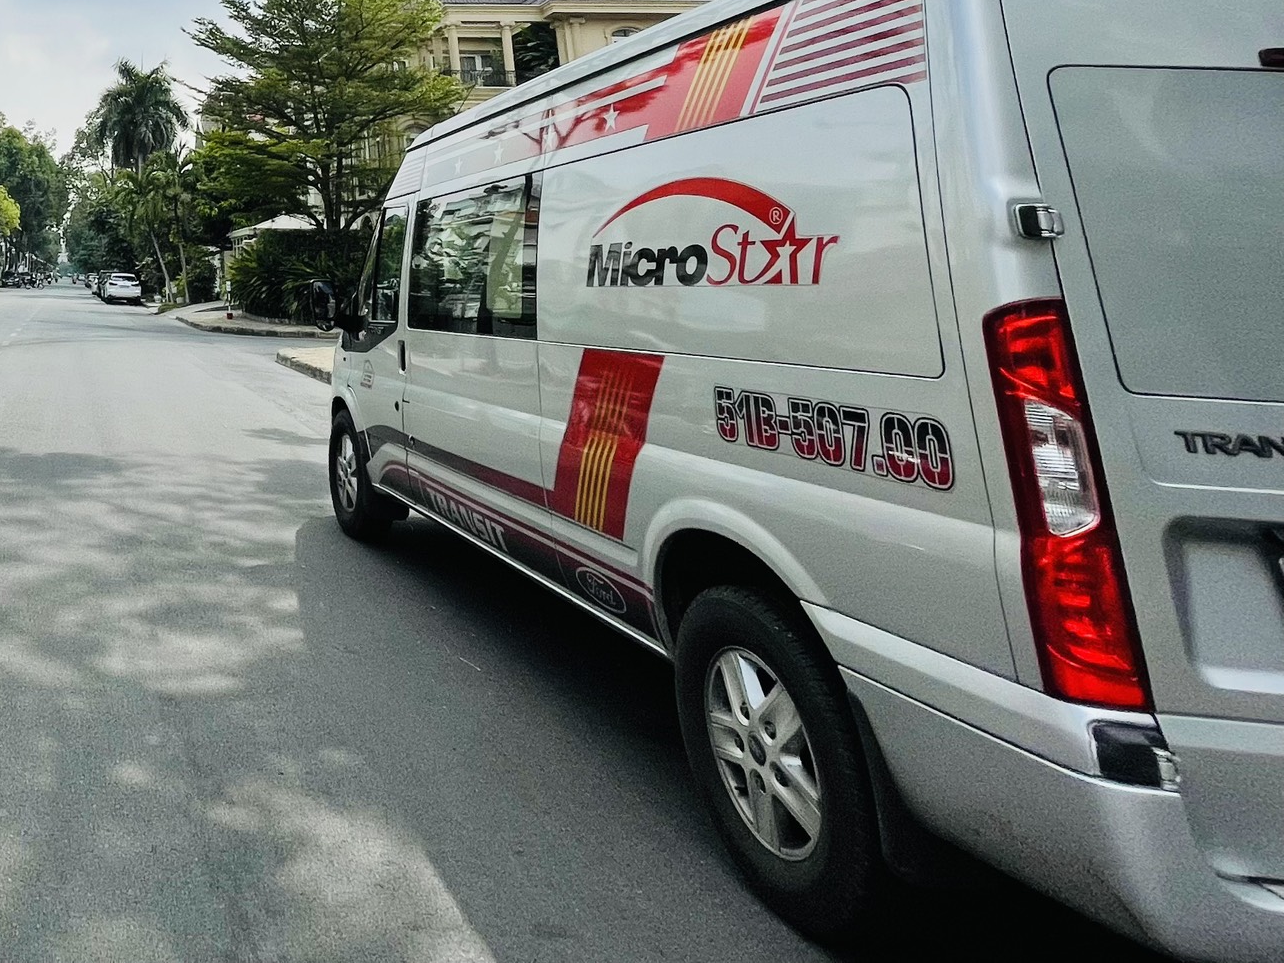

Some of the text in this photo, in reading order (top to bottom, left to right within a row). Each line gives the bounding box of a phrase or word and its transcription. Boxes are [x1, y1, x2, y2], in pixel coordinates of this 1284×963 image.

[714, 385, 956, 491] 51B-507.00
[425, 487, 509, 553] TRANSIT
[585, 571, 617, 606] Ford
